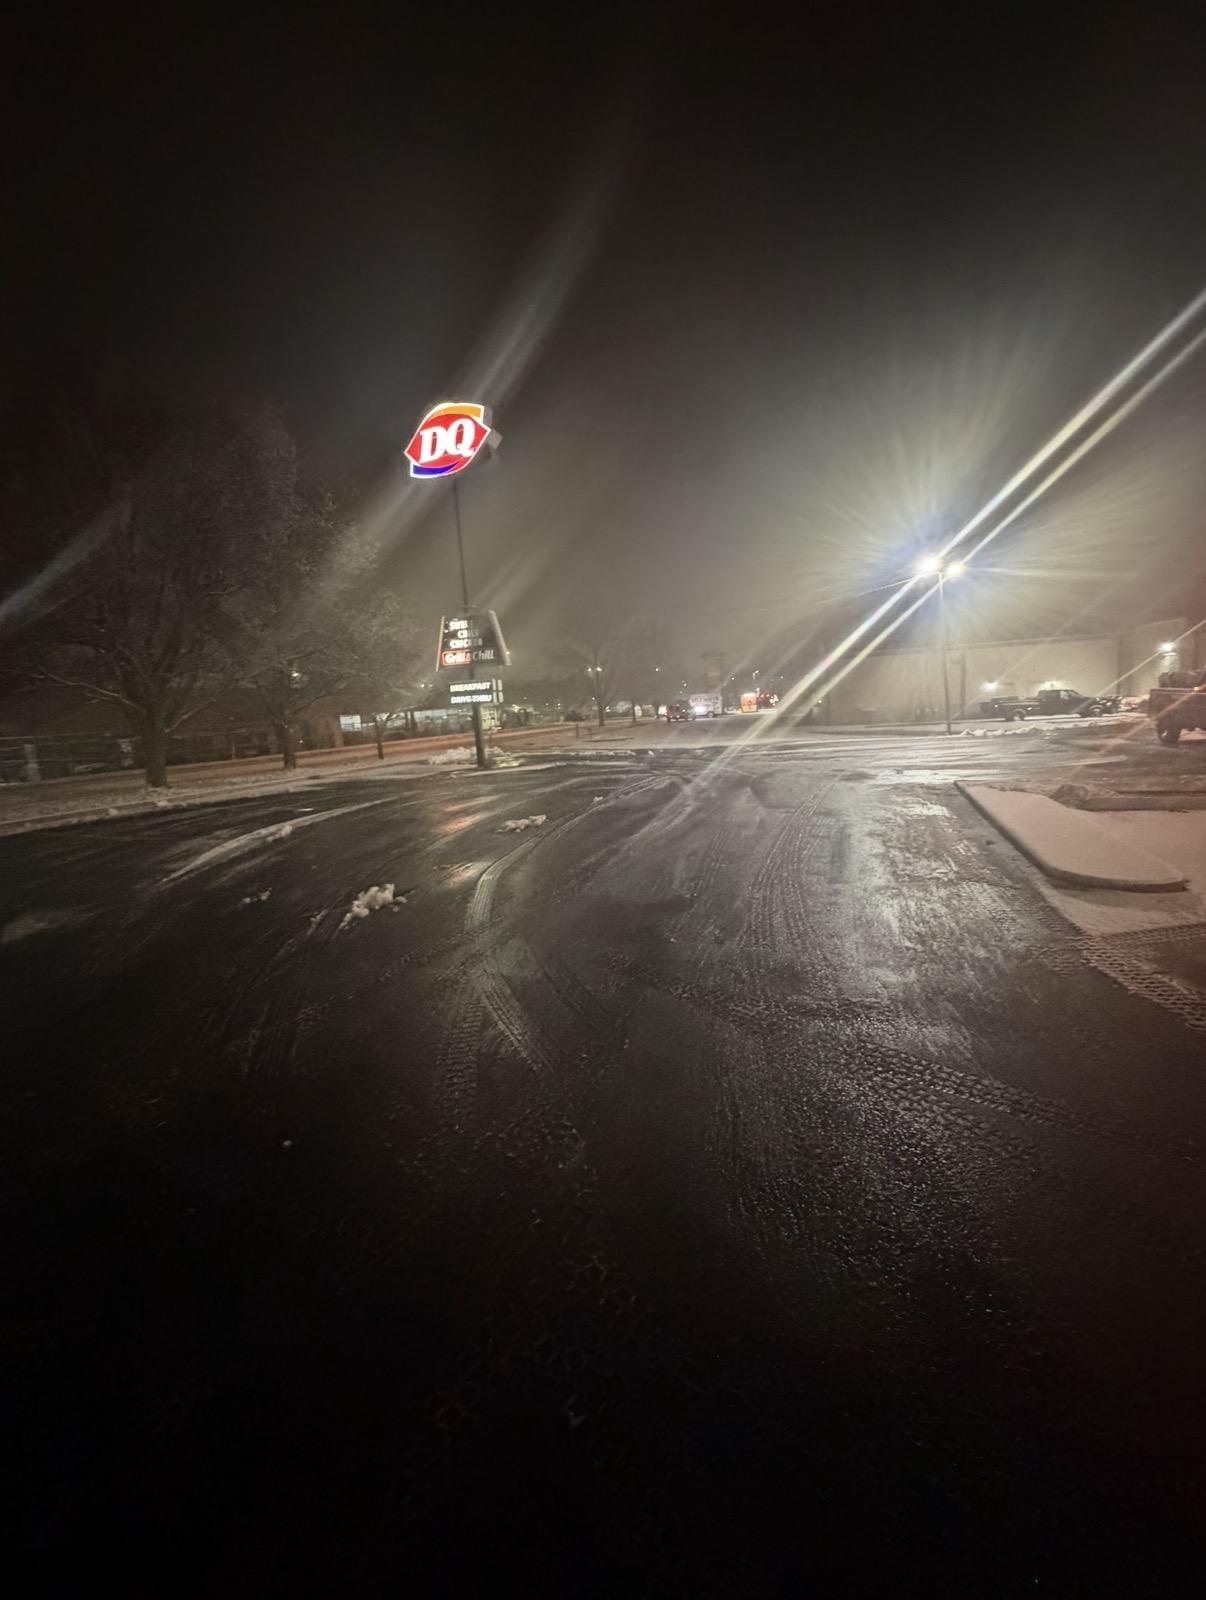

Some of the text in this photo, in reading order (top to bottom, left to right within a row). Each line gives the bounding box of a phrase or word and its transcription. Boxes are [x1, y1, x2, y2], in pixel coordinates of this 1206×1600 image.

[418, 418, 476, 463] DQ
[445, 652, 466, 664] Grill
[472, 650, 495, 660] Chill
[450, 682, 491, 692] BREAKFAST
[450, 695, 492, 704] DRIVE-THRU
